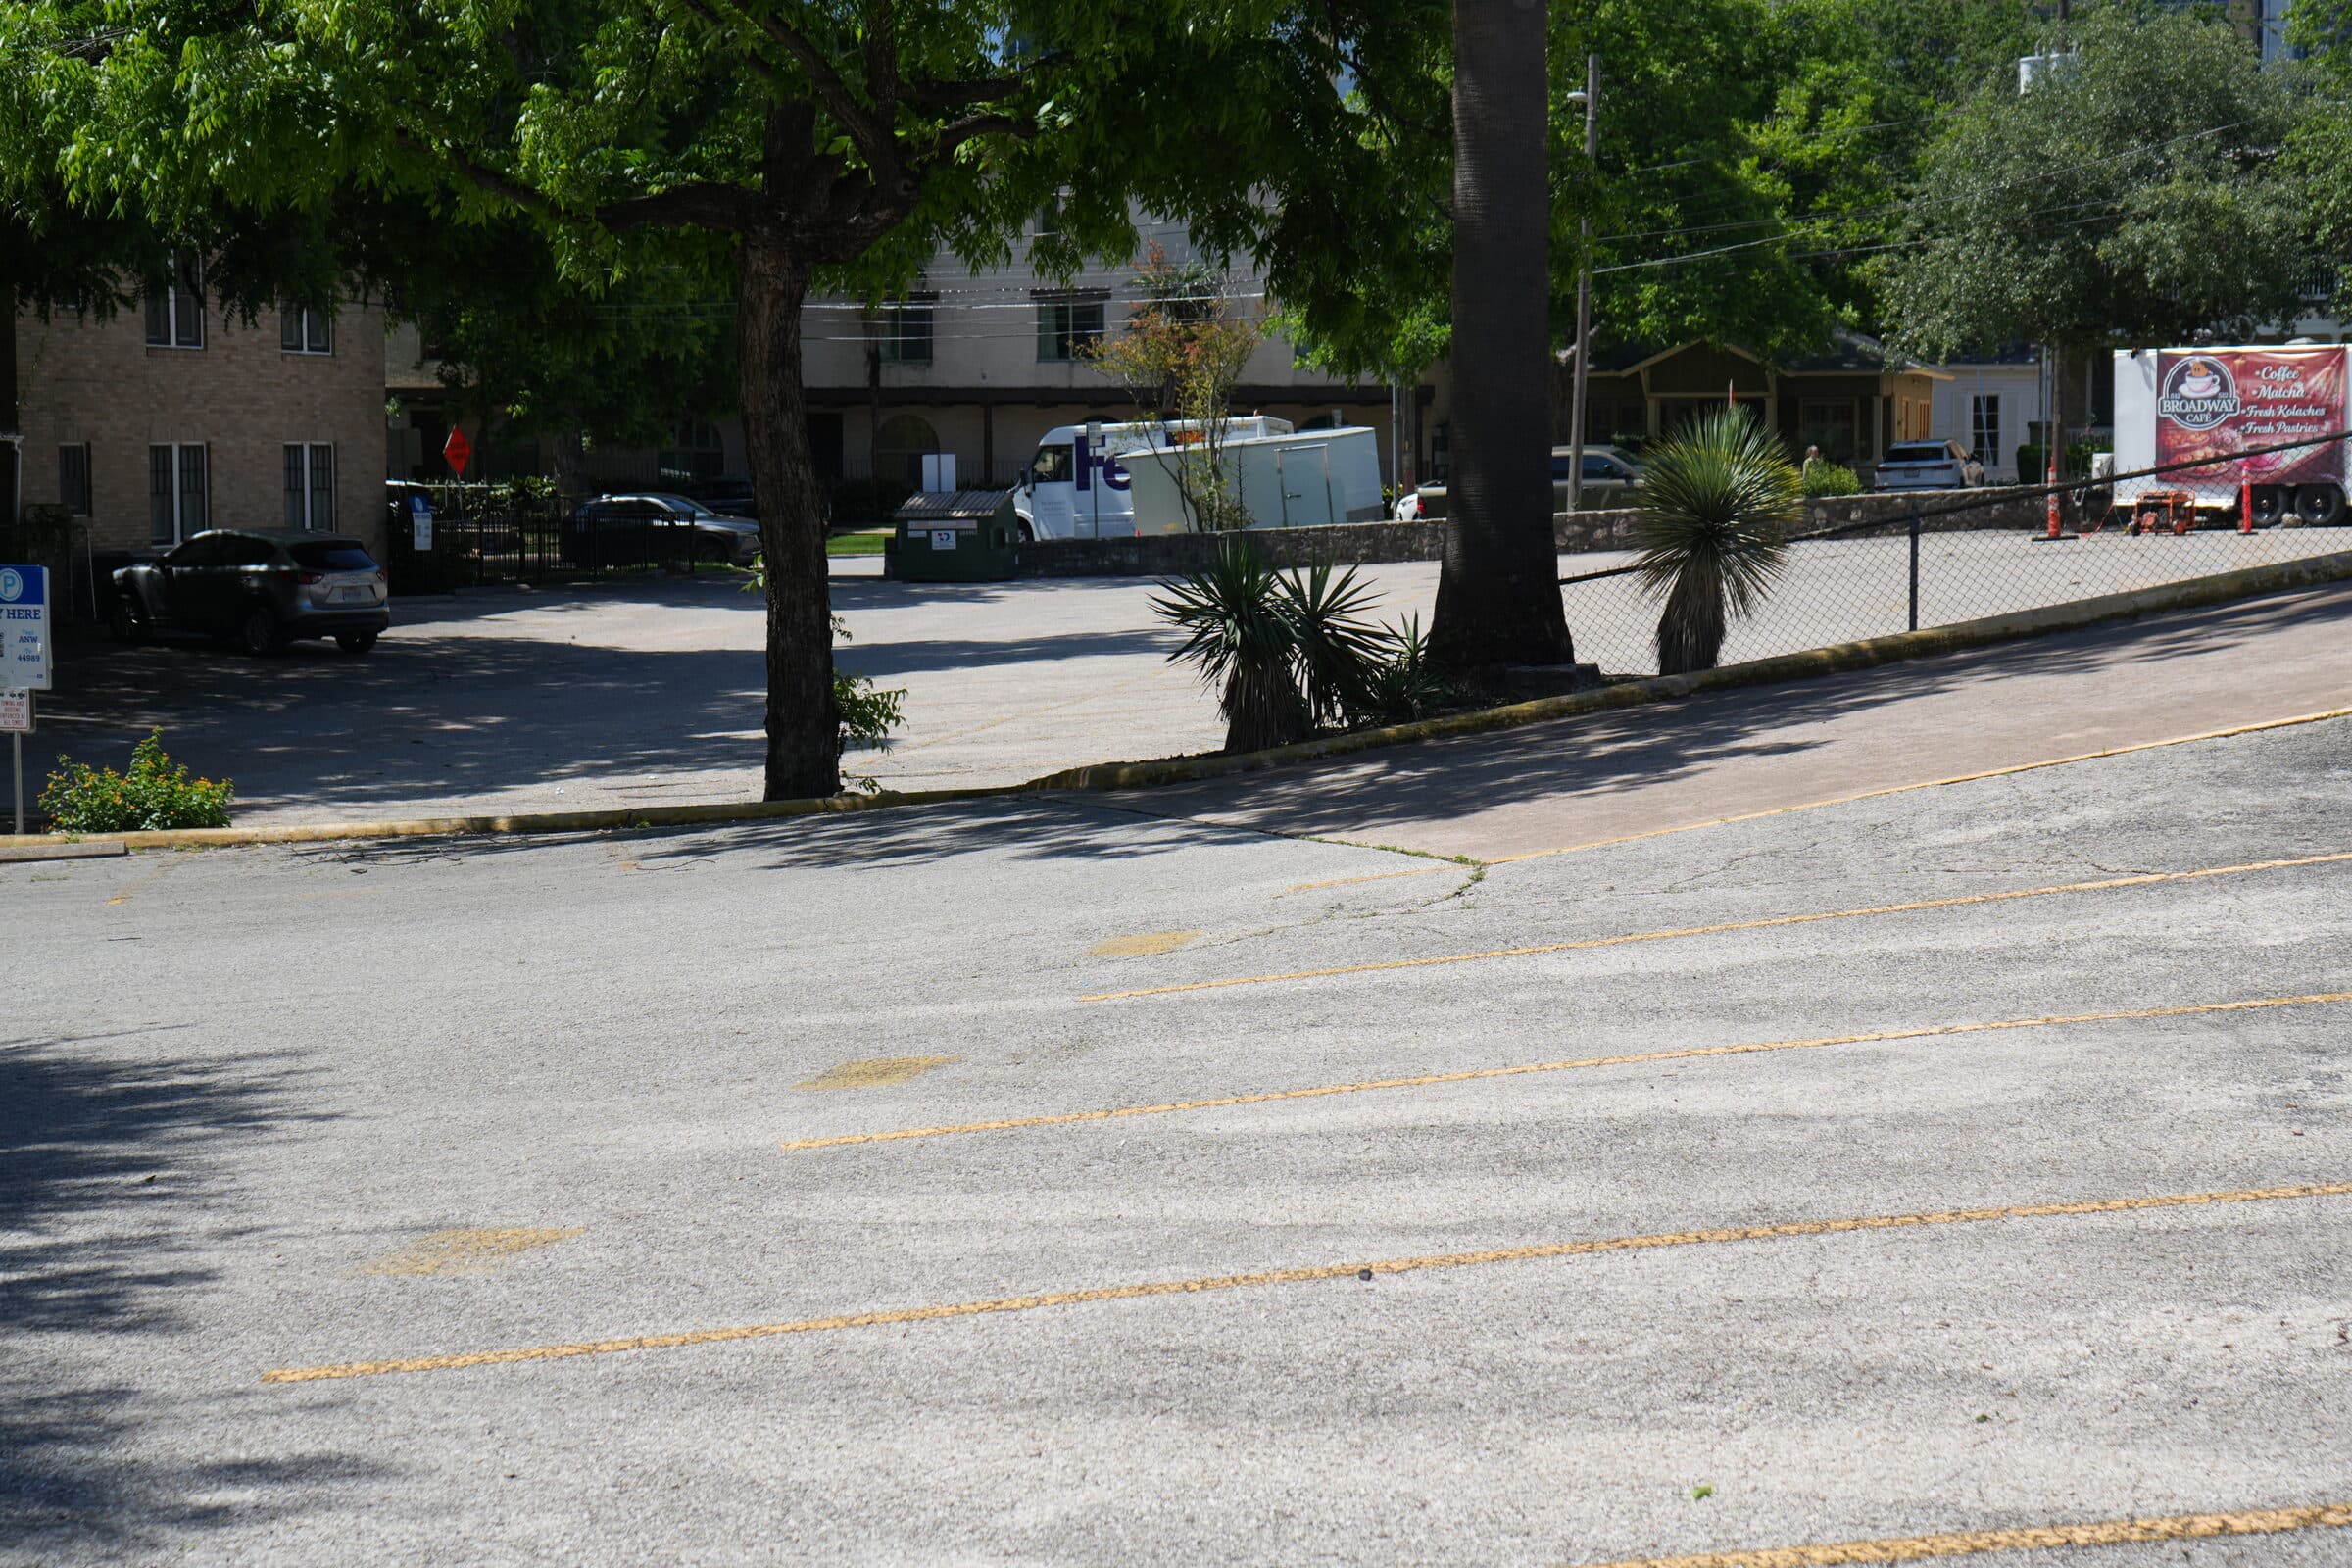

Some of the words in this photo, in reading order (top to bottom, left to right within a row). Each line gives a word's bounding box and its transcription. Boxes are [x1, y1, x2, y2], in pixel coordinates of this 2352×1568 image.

[2261, 365, 2299, 382] Coffee
[2257, 383, 2305, 399] Matcha
[2162, 399, 2236, 413] BROADWAY
[2245, 404, 2274, 416] Fresh
[2276, 404, 2326, 417] Kolaches
[2186, 413, 2212, 422] CAFÉ
[2244, 421, 2274, 434] Fresh
[2275, 421, 2318, 434] Pastries
[7, 609, 41, 620] HERE
